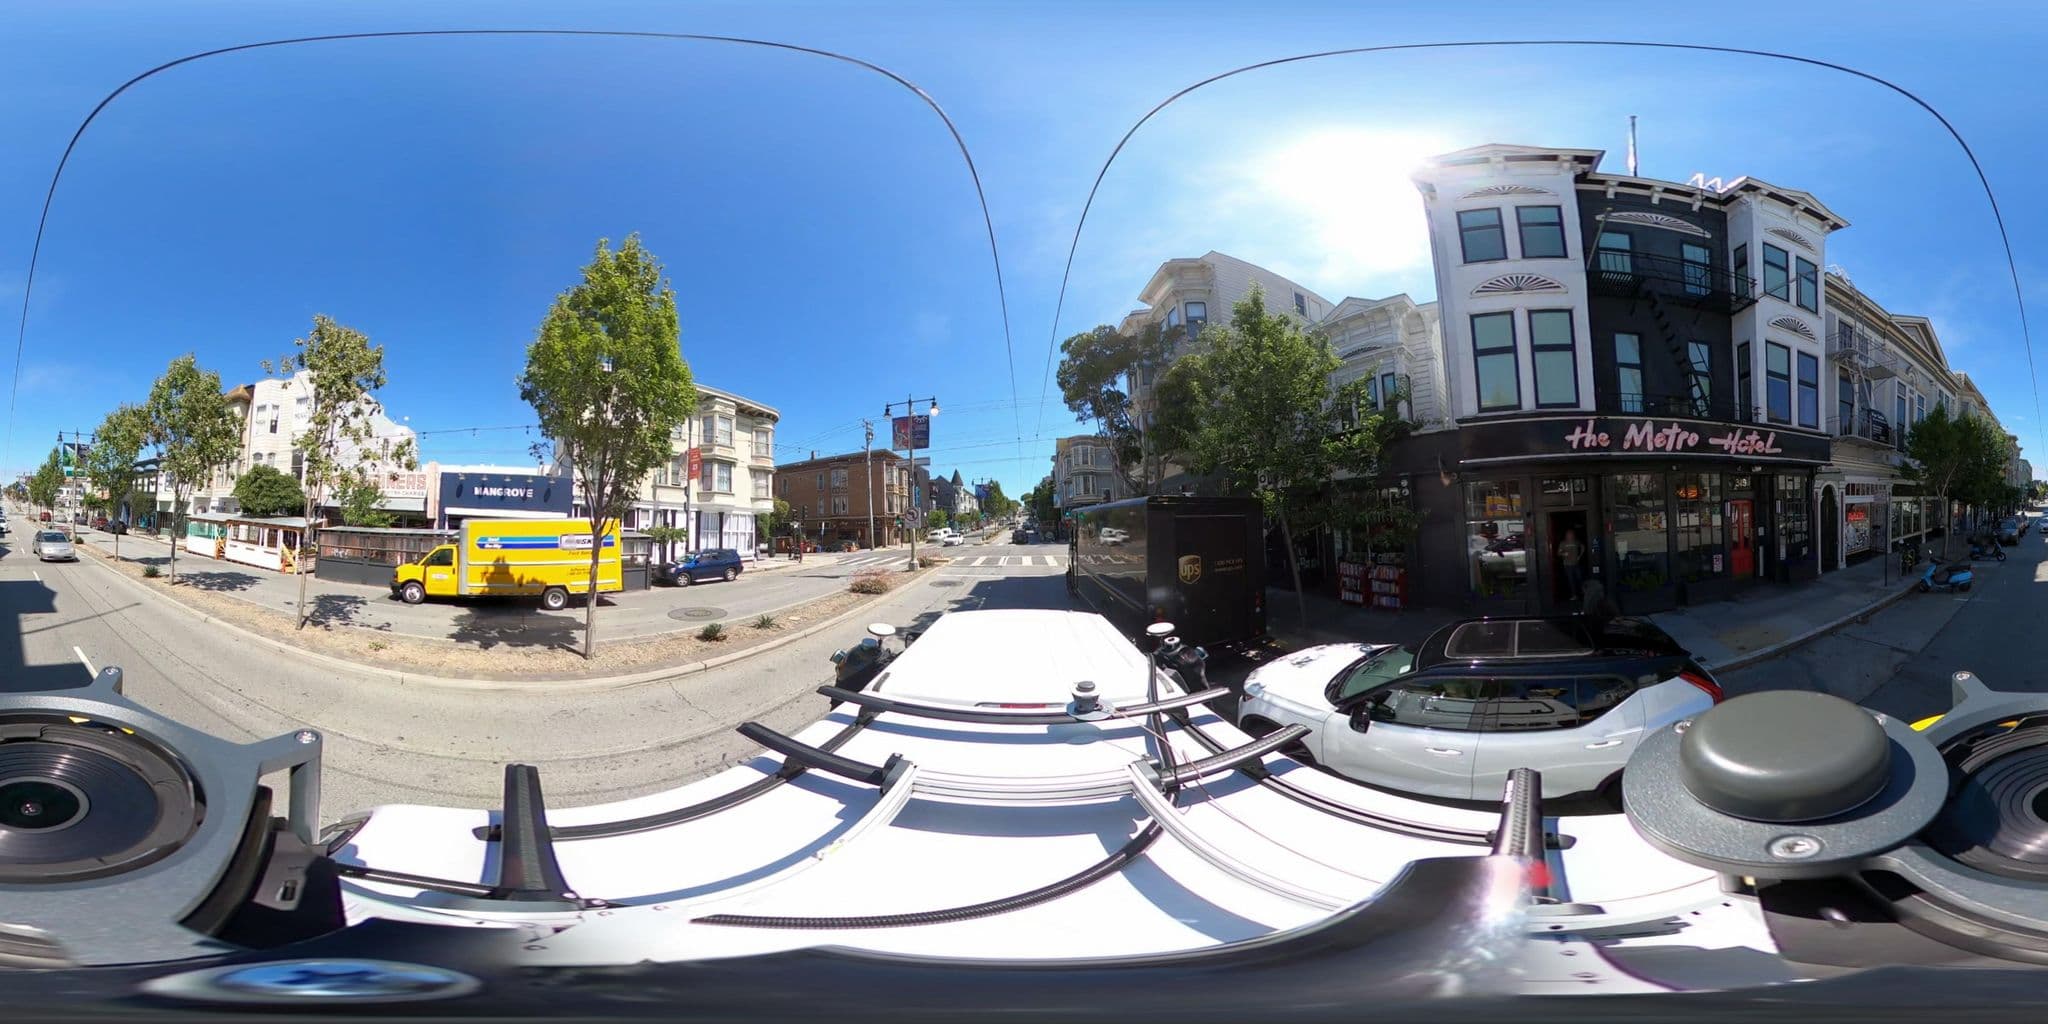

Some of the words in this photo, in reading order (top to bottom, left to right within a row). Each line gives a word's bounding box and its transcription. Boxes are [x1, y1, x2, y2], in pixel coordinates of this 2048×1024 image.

[1565, 419, 1610, 449] the
[1623, 420, 1699, 452] Metro
[474, 486, 534, 497] MANGROVE
[1181, 563, 1200, 580] ups
